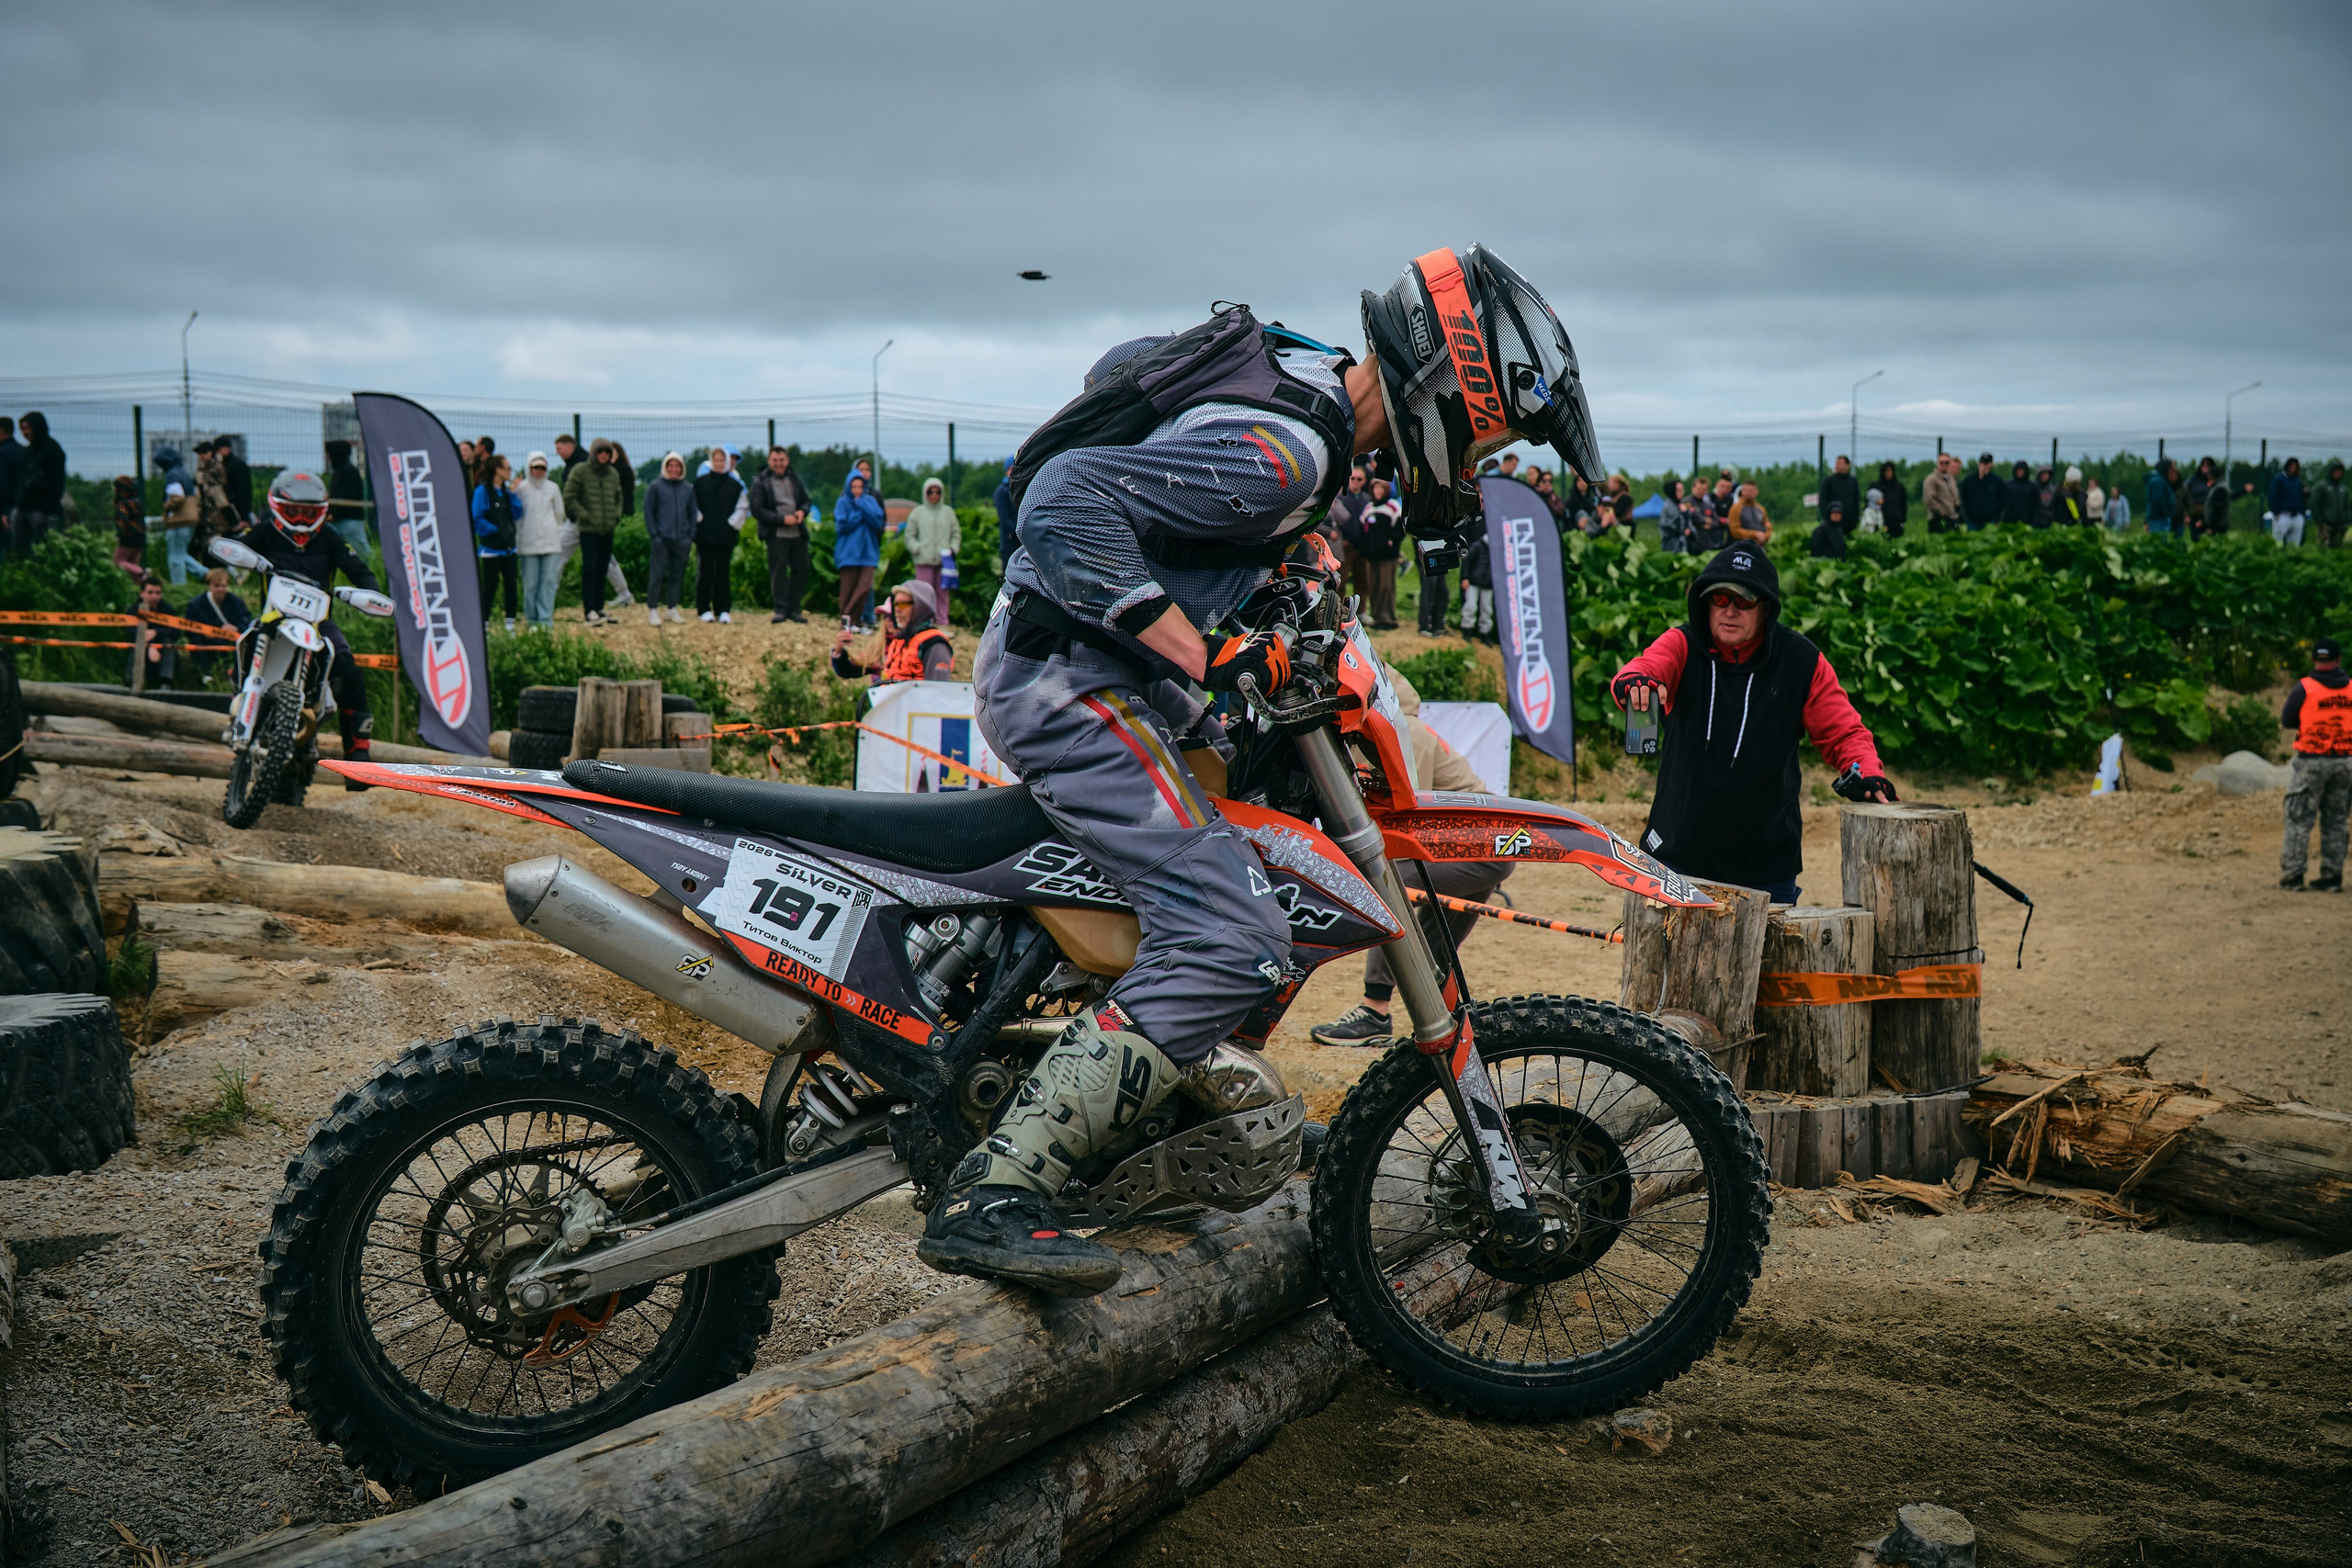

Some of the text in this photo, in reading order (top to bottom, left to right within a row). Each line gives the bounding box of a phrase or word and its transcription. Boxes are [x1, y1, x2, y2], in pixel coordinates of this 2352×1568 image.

[1411, 311, 1432, 357] SHOEI
[1443, 310, 1504, 431] 100%
[742, 920, 822, 964] Титов Виктор
[748, 878, 842, 942] 191
[765, 951, 903, 1030] READY TO RACE
[1480, 1129, 1528, 1211] KTM
